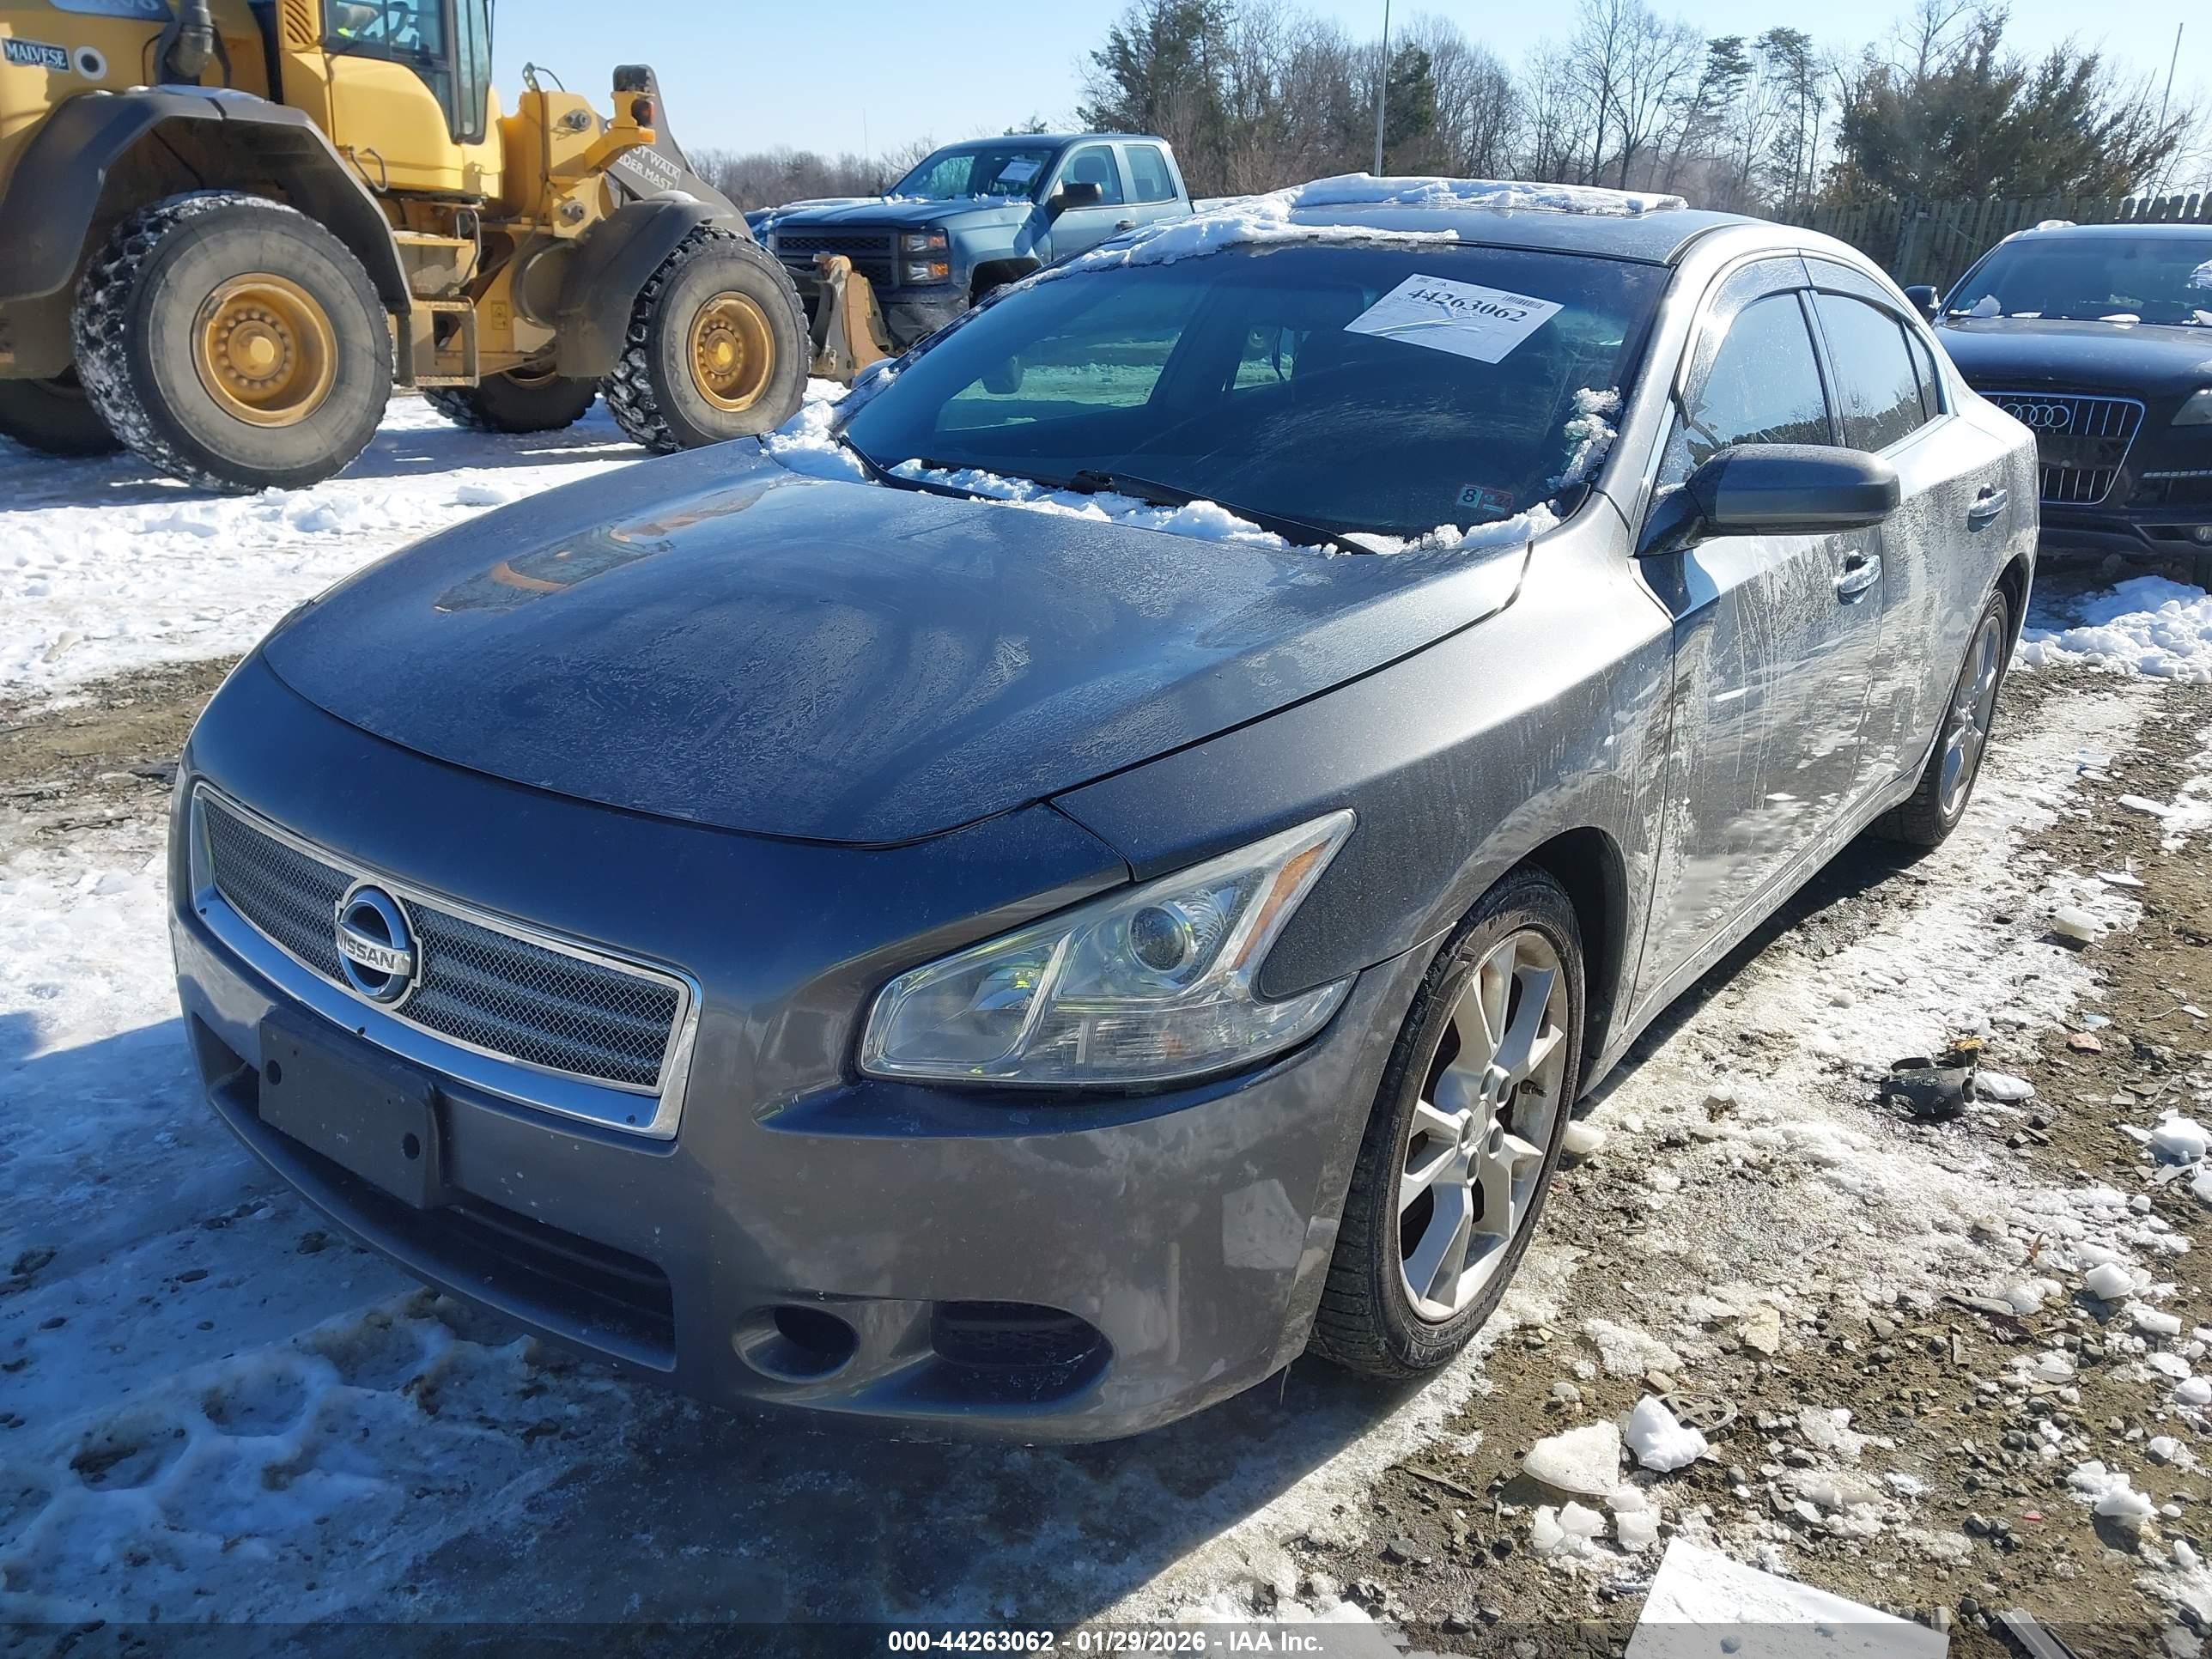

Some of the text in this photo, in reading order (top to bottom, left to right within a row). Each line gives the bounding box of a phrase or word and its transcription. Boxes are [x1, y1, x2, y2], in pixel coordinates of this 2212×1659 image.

[643, 167, 674, 191] MAST
[650, 151, 679, 179] WALK
[1407, 288, 1529, 323] 44263062
[1462, 488, 1478, 503] 8
[337, 930, 396, 969] NISSAN
